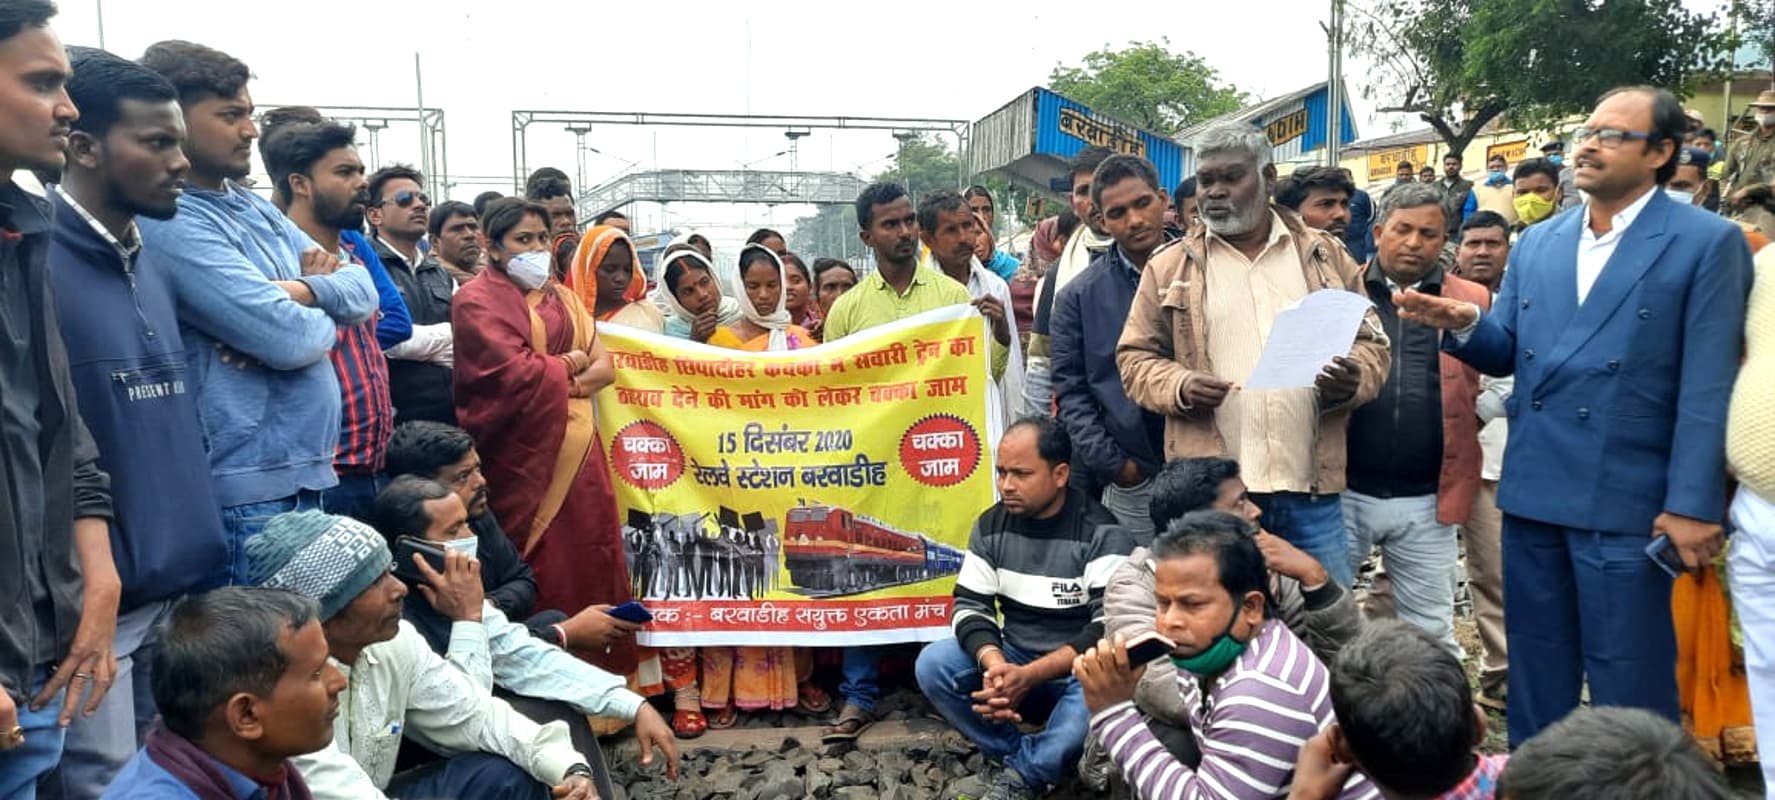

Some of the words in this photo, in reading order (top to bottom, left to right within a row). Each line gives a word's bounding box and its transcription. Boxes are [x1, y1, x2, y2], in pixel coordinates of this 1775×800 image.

[608, 350, 669, 374] रवाडीह
[854, 342, 908, 369] सवारी
[913, 338, 942, 365] ट्रेन
[947, 336, 975, 356] का
[128, 382, 169, 402] PRESENT
[671, 384, 699, 408] देने
[704, 387, 731, 409] की
[735, 388, 776, 408] मांग
[815, 386, 862, 407] लेकर
[868, 381, 917, 403] चक्का
[924, 376, 968, 397] जाम
[622, 436, 672, 454] चक्का
[718, 431, 737, 454] 15
[743, 422, 811, 454] दिसंबर
[814, 429, 853, 453] 2020
[911, 431, 964, 451] चक्का
[628, 461, 669, 480] जाम
[691, 457, 732, 488] रेलवे
[736, 458, 795, 489] स्टेशन
[801, 453, 888, 488] बरवाडीह
[918, 458, 961, 477] जाम
[1051, 582, 1082, 593] FILA
[710, 602, 790, 624] बरवाडीह
[854, 604, 909, 627] एकता
[914, 599, 948, 620] मंच
